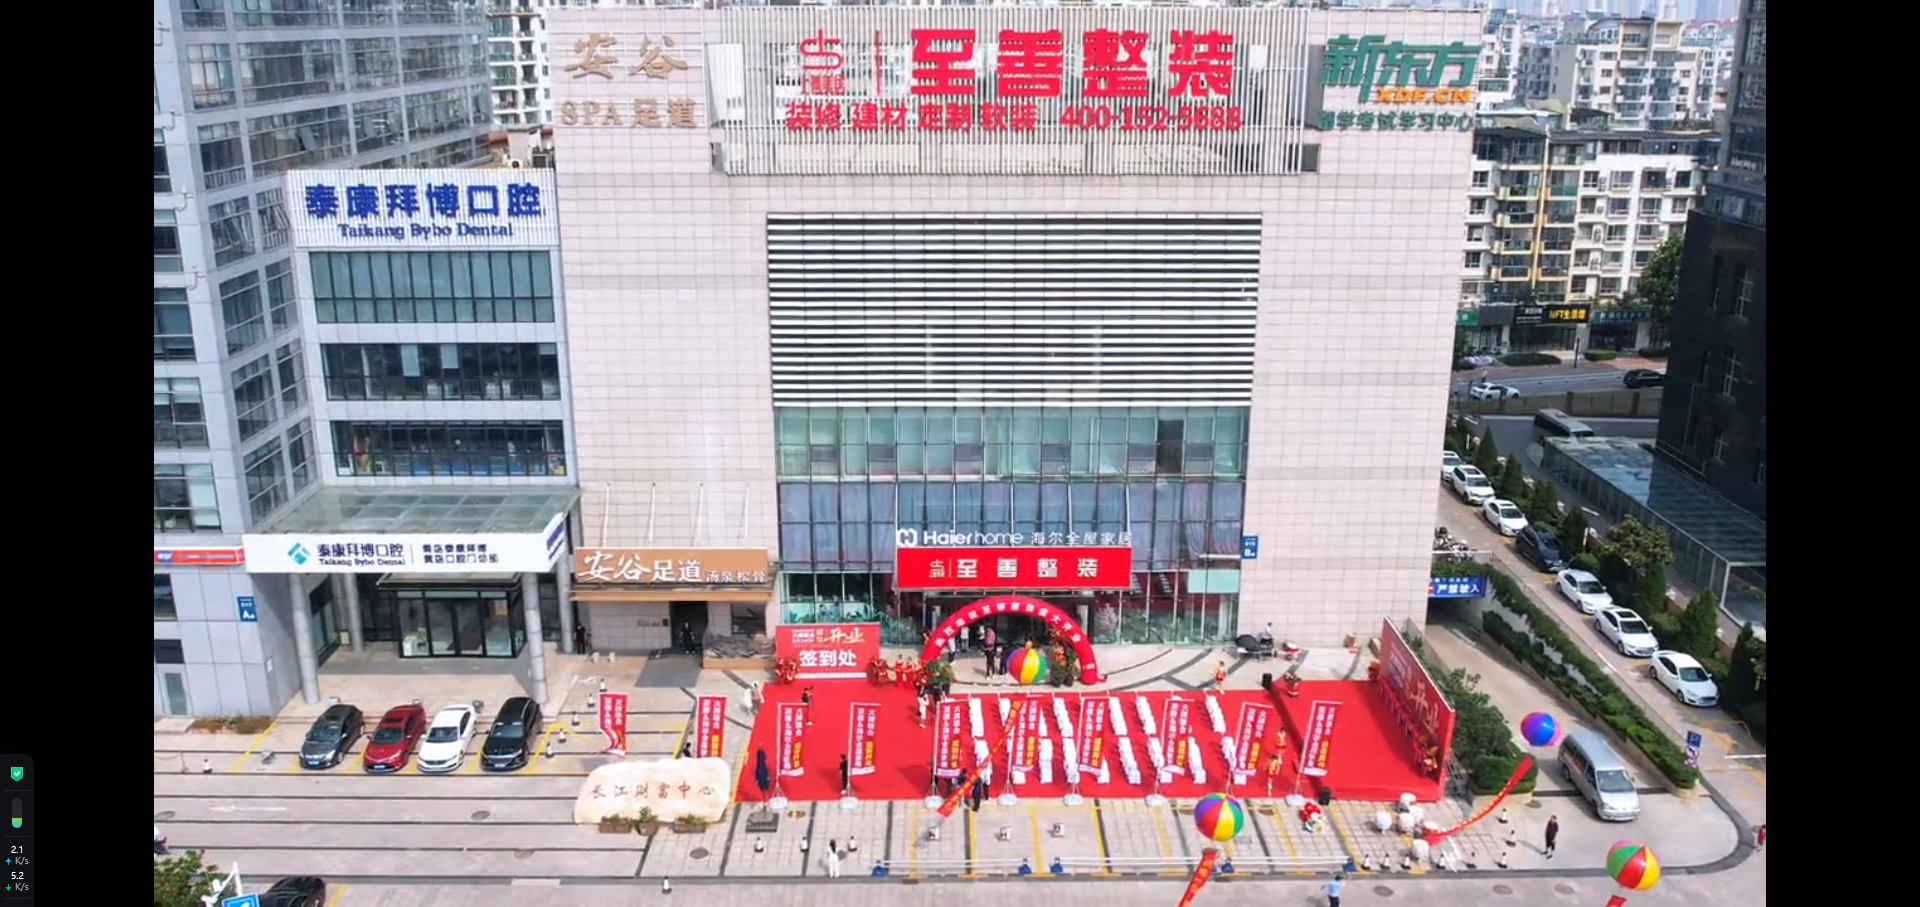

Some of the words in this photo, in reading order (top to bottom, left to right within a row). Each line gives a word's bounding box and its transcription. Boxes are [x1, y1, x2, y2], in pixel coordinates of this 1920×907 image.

[564, 32, 689, 80] 安谷
[910, 28, 1234, 98] 至善整装
[1319, 34, 1482, 103] 新东方
[1374, 88, 1473, 104] XDF.CN
[561, 101, 622, 126] SPA
[630, 98, 697, 128] 足道
[785, 102, 842, 132] 装修
[851, 102, 908, 132] 建材
[917, 102, 972, 132] 定制
[980, 102, 1038, 132] 软装
[1060, 103, 1243, 132] 400-152-5688
[305, 182, 541, 219] 泰康拜博口腔
[337, 223, 405, 240] Taikang
[410, 222, 452, 240] Bybo
[456, 222, 514, 238] Dental
[317, 542, 404, 558] 泰康拜博口腔
[1030, 531, 1132, 546] 海尔全屋家居
[578, 551, 702, 583] 安谷足道
[956, 557, 1099, 578] 至善整装
[799, 649, 858, 667] 签到处
[591, 780, 716, 799] 长江财富中心
